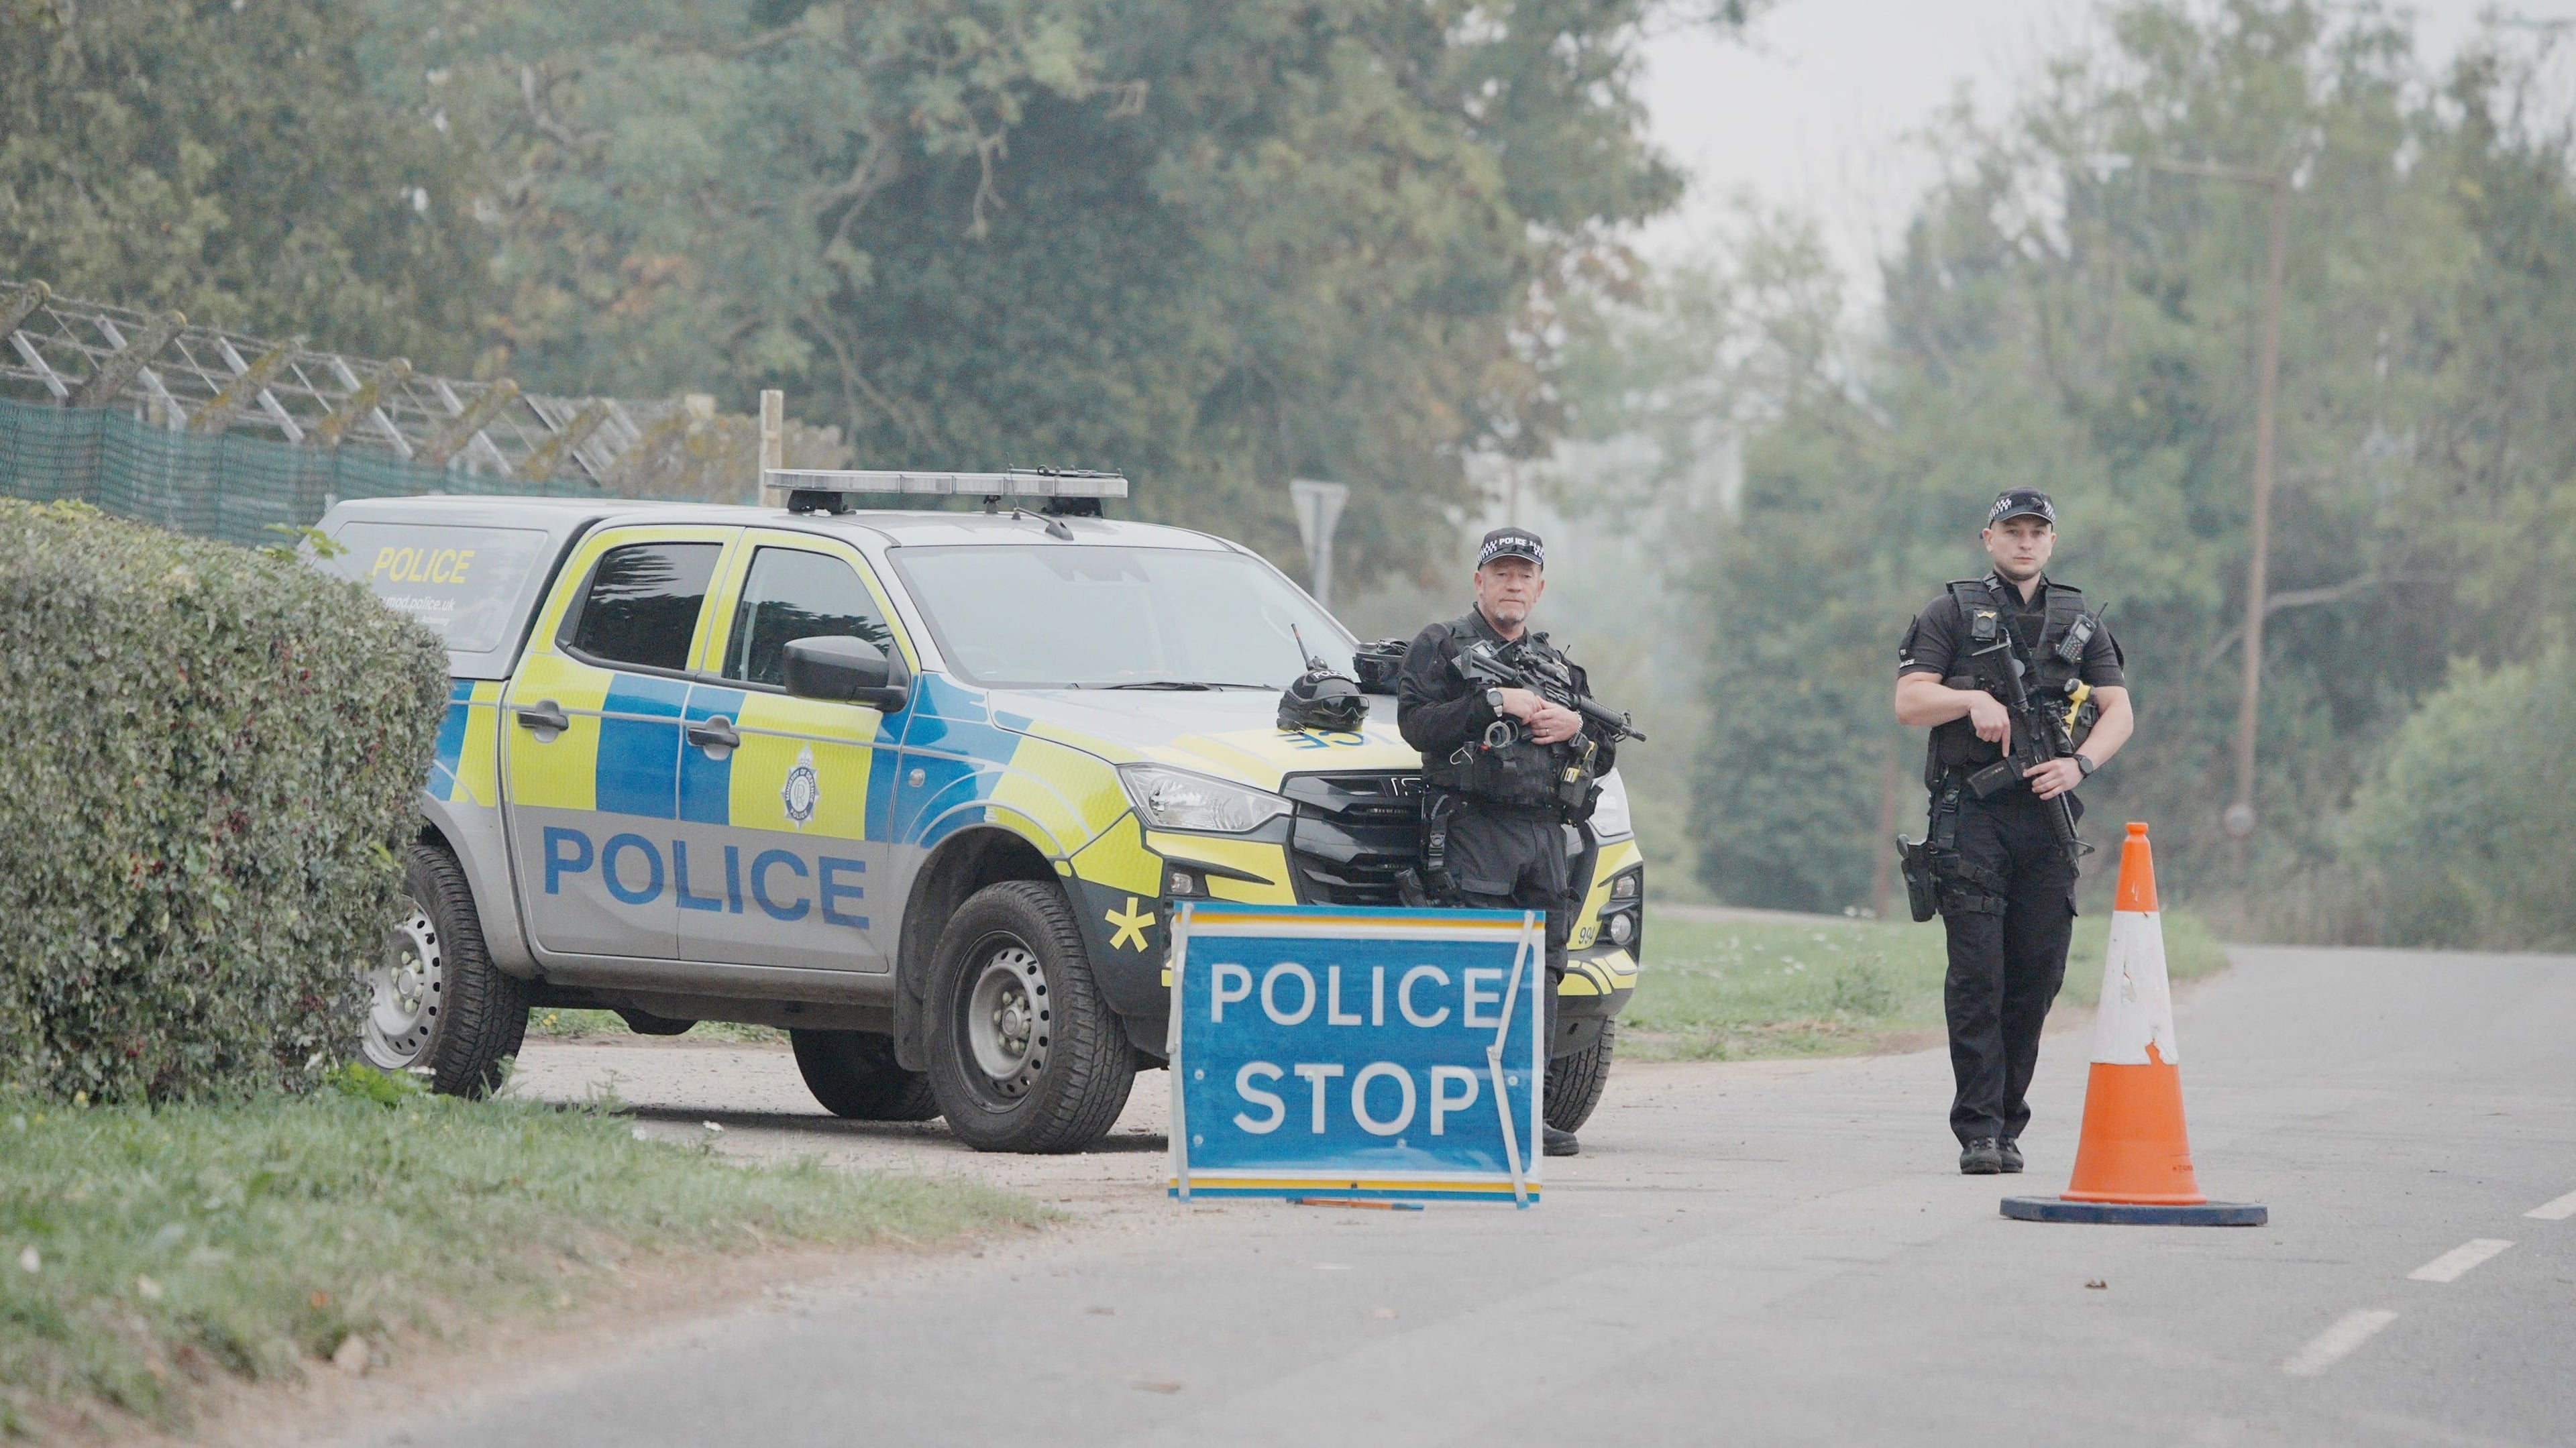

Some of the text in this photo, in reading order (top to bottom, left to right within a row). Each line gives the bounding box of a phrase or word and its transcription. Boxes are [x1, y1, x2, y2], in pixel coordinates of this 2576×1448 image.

[1499, 537, 1527, 546] POLICE
[372, 547, 476, 583] POLICE
[378, 595, 456, 612] .mod.police.uk
[785, 770, 799, 801] MINISTRY
[790, 808, 808, 819] POLICE
[543, 826, 870, 930] POLICE
[1211, 962, 1503, 1027] POLICE
[1233, 1060, 1479, 1136] STOP
